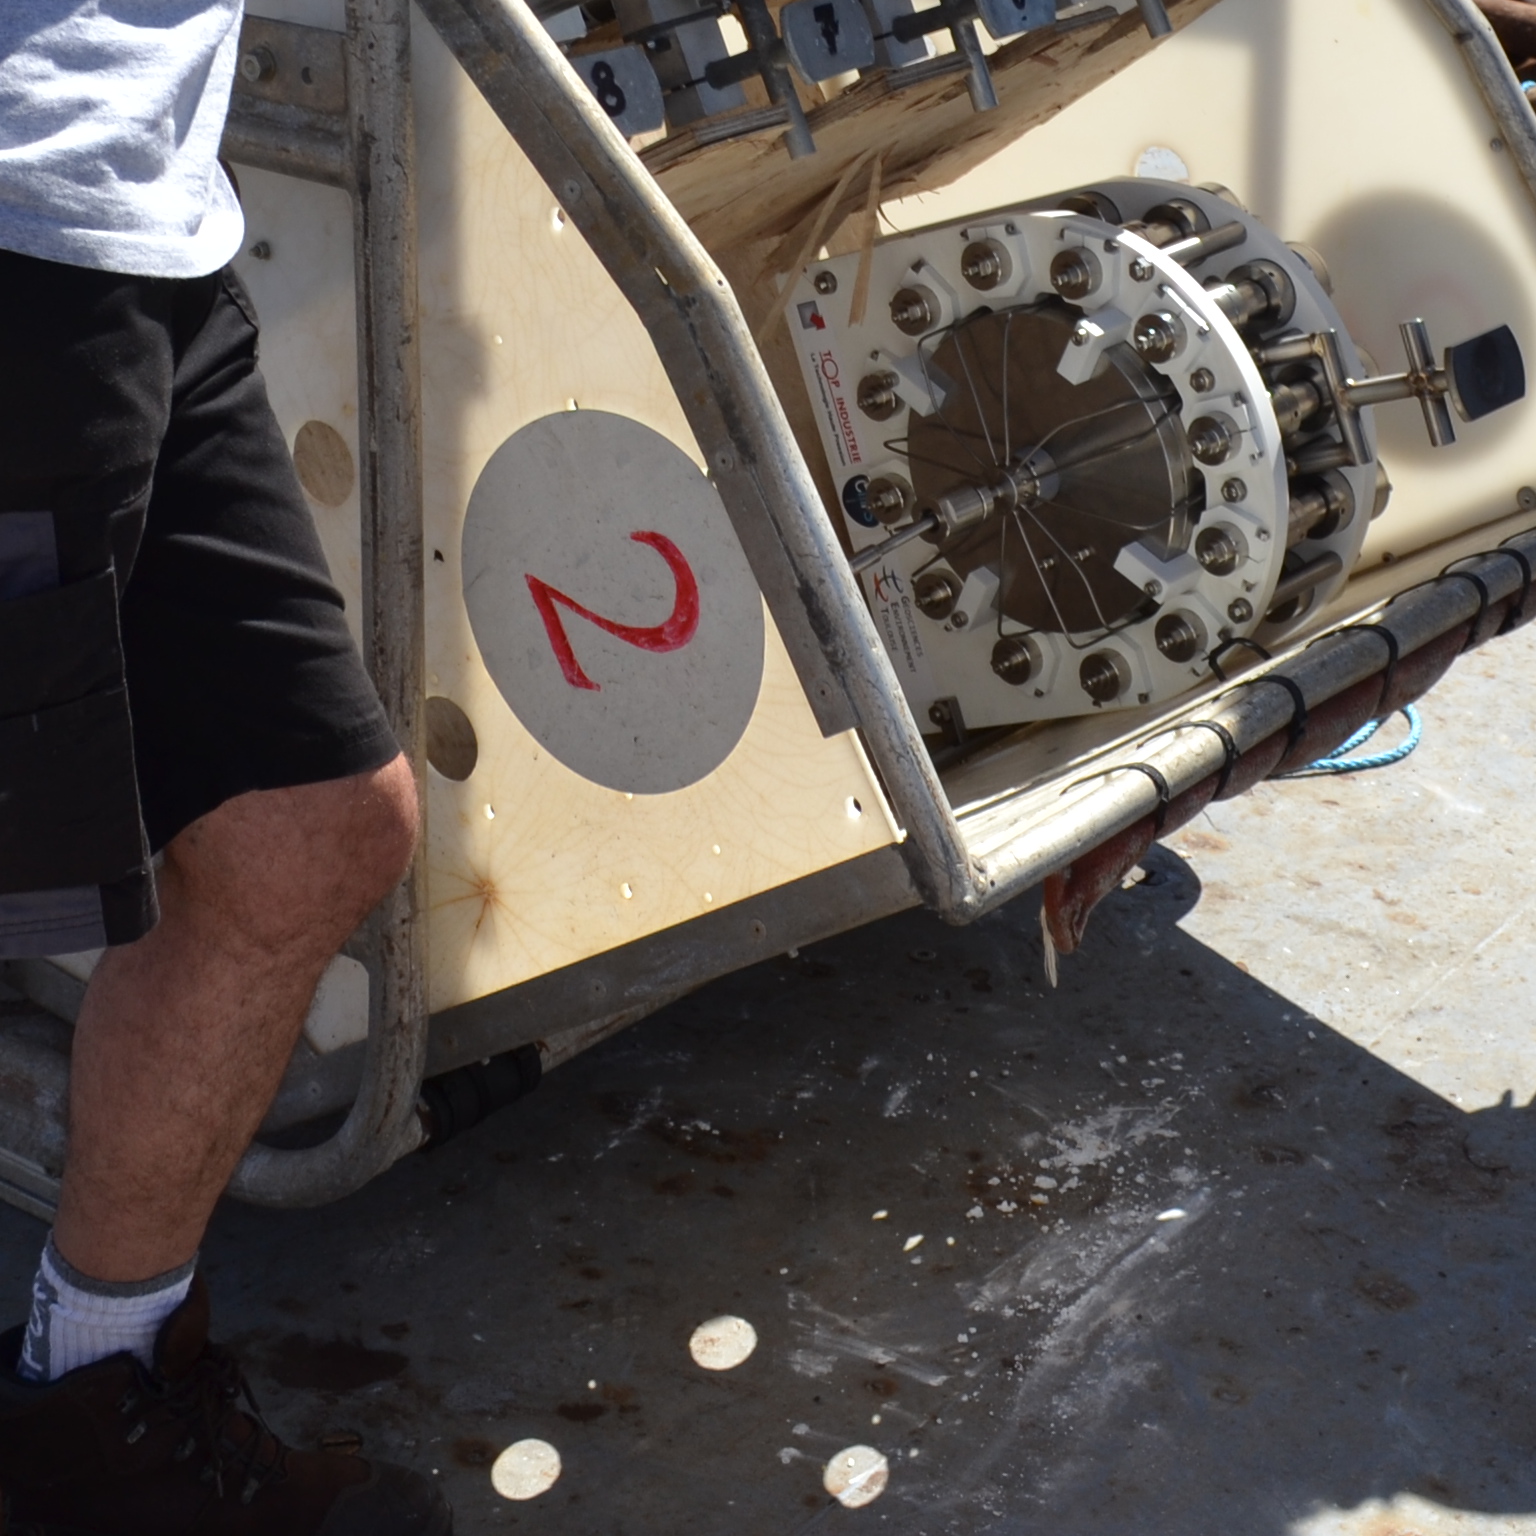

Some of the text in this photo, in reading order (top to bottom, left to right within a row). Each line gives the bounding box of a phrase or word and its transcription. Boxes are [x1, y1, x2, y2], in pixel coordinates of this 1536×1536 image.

[591, 61, 626, 117] 8
[821, 350, 862, 463] TOP INDUSTRIE
[834, 433, 846, 466] Pression
[524, 530, 700, 692] 2
